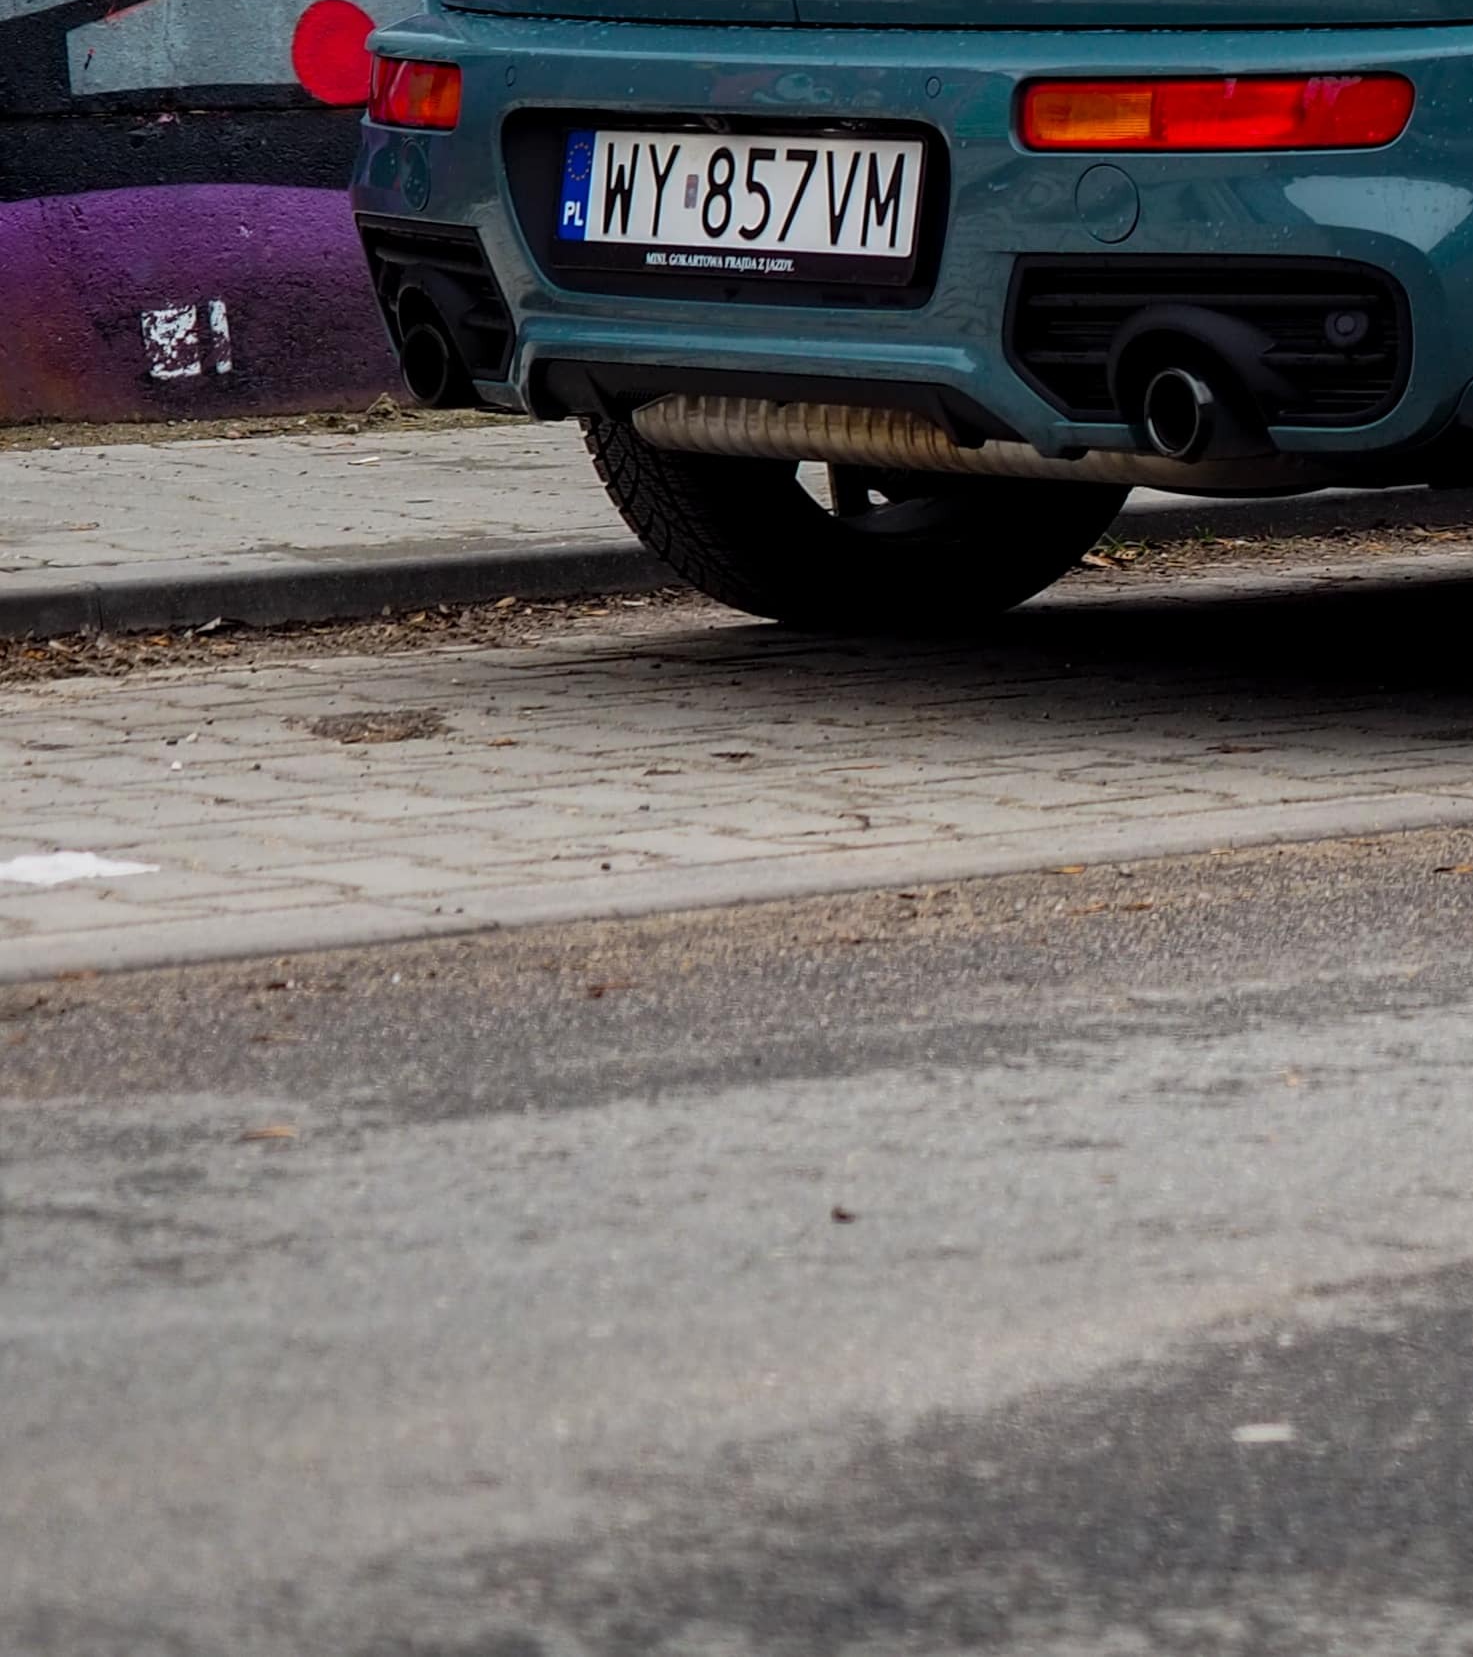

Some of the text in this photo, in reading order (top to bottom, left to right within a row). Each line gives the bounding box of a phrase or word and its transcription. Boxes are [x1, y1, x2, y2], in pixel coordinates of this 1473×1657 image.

[603, 142, 905, 248] WY 857VM
[563, 201, 584, 227] PL
[758, 258, 765, 270] Z
